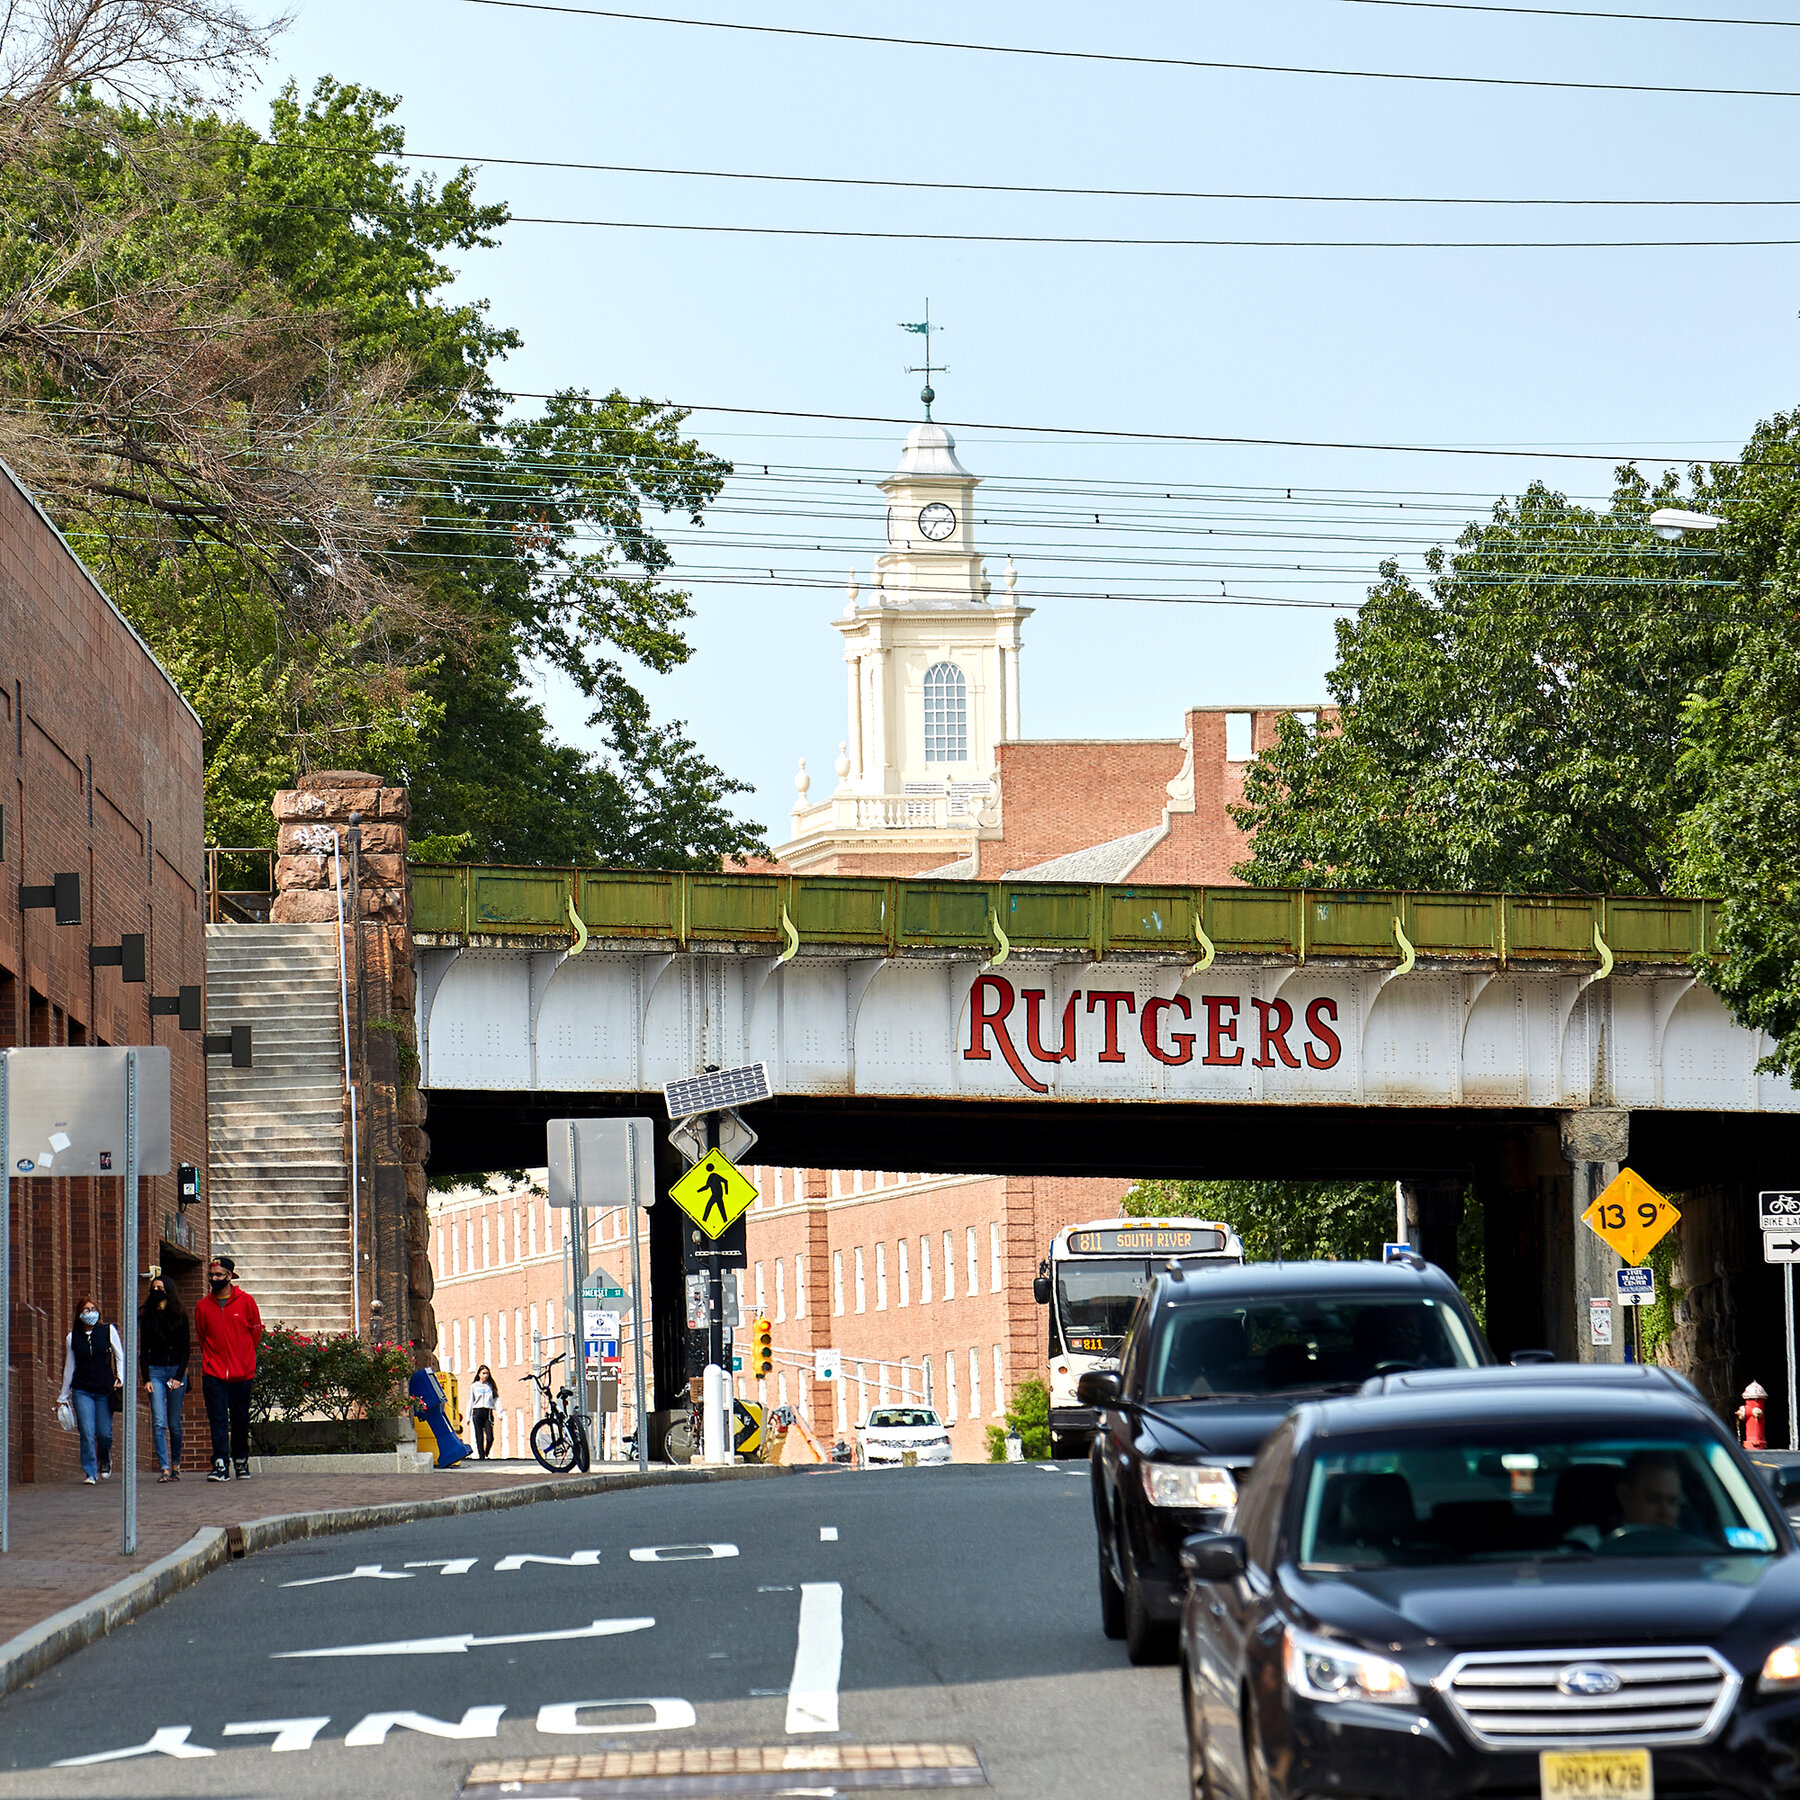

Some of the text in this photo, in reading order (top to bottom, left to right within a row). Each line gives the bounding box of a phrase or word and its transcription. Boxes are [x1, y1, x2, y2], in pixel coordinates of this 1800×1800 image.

[963, 974, 1342, 1094] RUTGERS
[1598, 1204, 1626, 1229] 13
[1764, 1217, 1783, 1226] BIKE
[1080, 1232, 1192, 1251] 811 SOUTH RIVER
[1083, 1338, 1103, 1350] 811
[49, 1697, 697, 1768] ONLY
